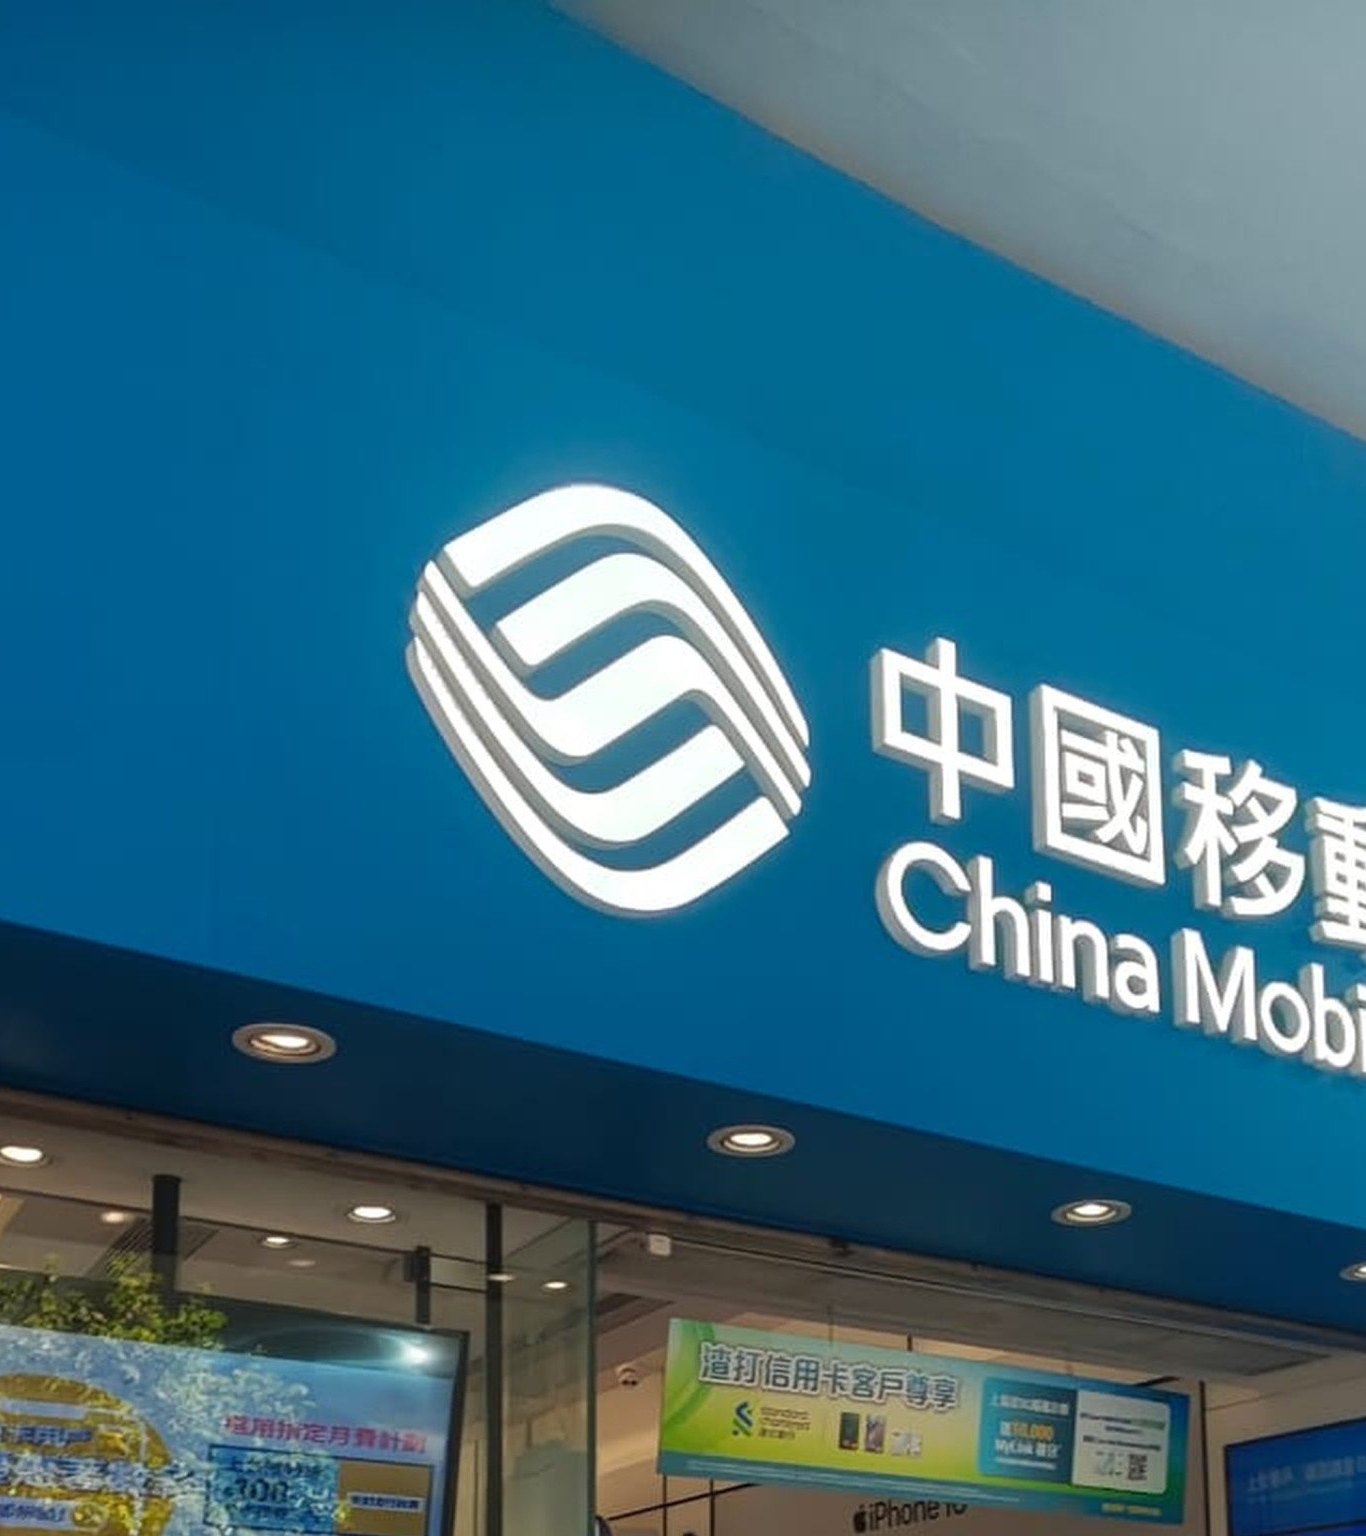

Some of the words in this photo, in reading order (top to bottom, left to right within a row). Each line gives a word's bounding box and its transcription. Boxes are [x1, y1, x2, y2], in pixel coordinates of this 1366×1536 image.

[875, 841, 1160, 1015] China
[699, 1342, 958, 1411] 渣打信用卡客戶尊享
[868, 1499, 939, 1532] iPhone
